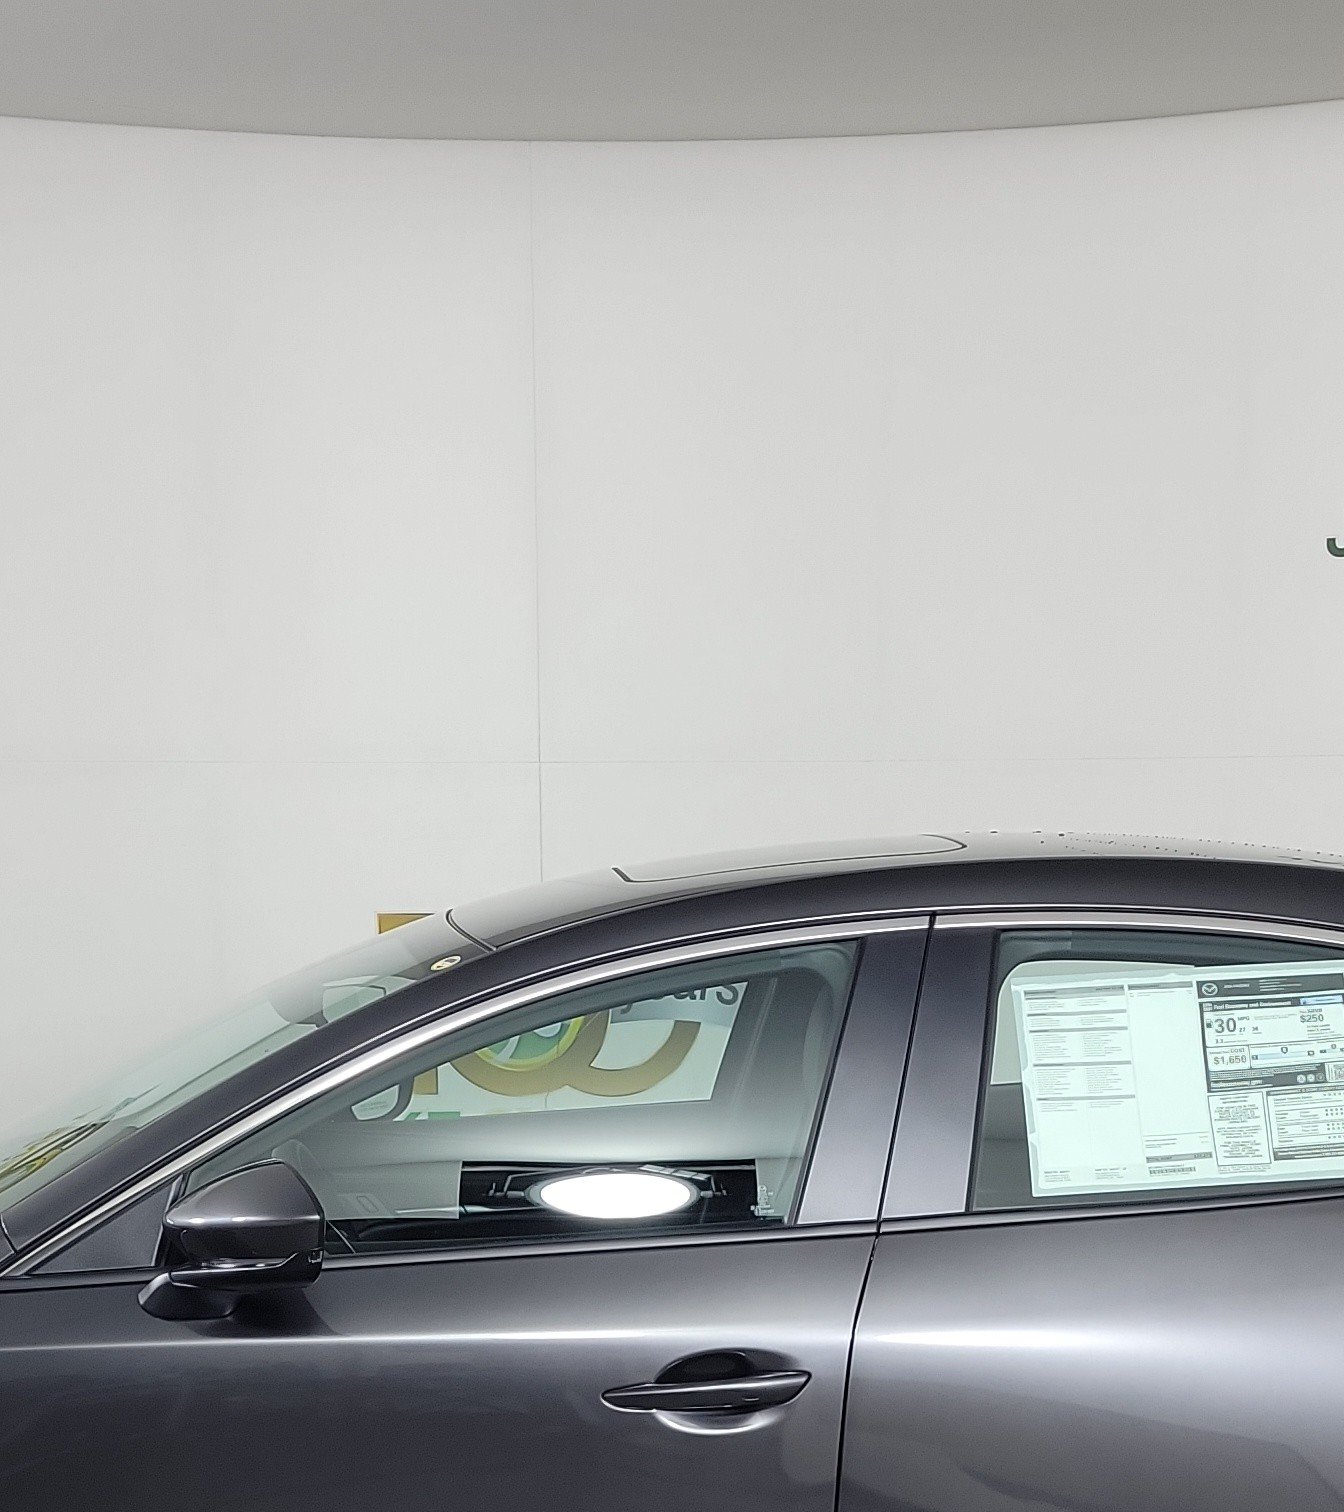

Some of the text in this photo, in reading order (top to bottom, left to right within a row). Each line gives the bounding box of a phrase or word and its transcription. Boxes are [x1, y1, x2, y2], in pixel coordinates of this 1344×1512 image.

[1299, 1013, 1324, 1023] $250
[1214, 1017, 1237, 1034] 30
[1213, 1054, 1247, 1066] $1,650
